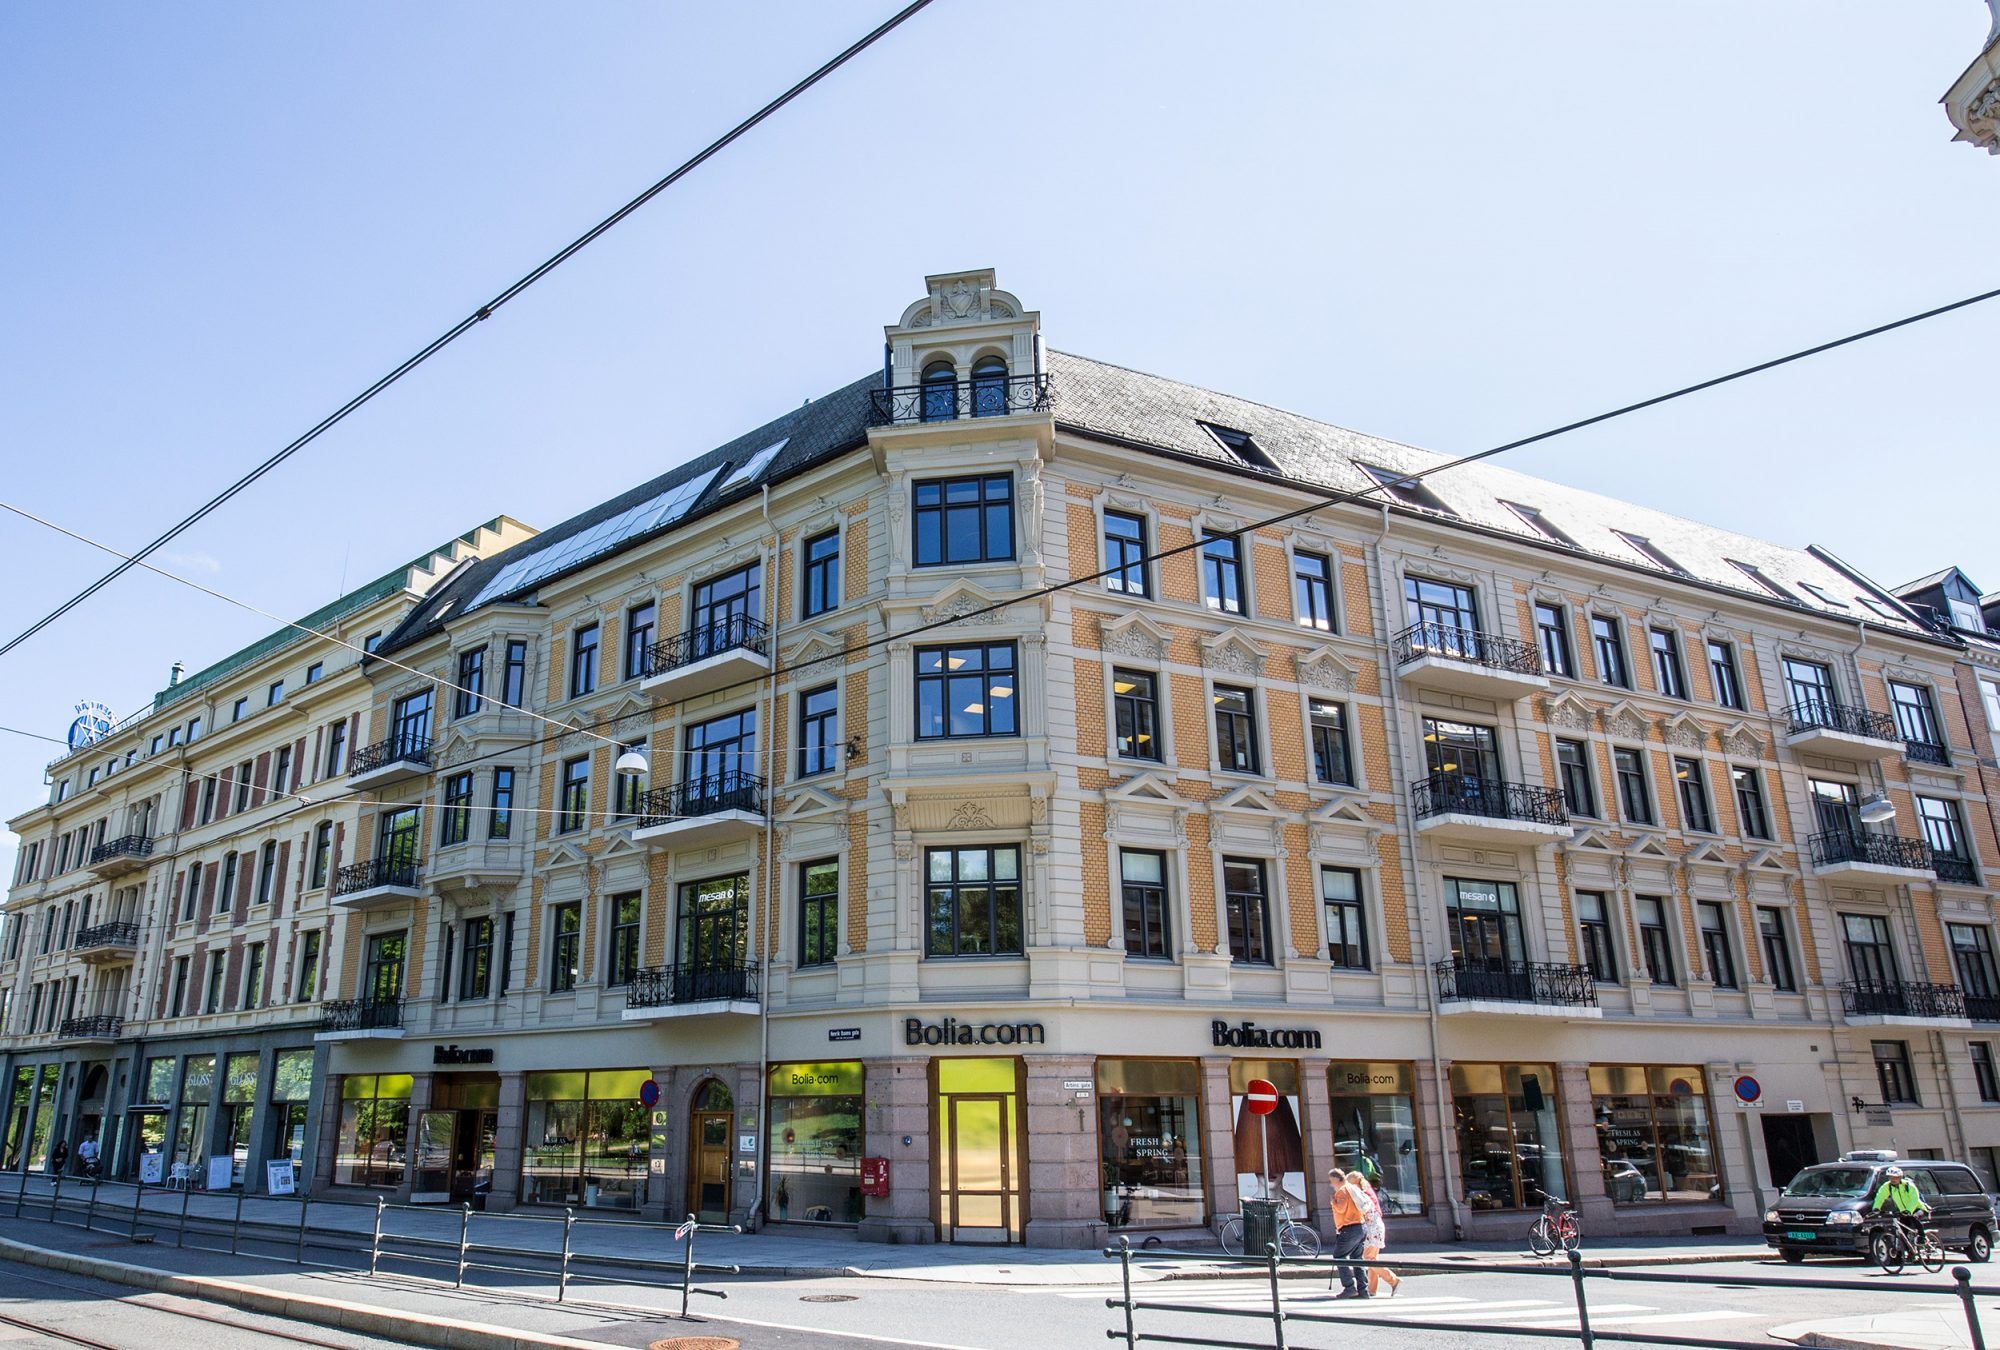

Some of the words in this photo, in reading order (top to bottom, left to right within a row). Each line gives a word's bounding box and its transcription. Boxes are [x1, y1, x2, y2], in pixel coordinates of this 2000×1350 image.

[699, 891, 726, 903] mesan
[1460, 891, 1488, 902] mesan
[906, 1017, 1044, 1046] Bolia.com
[1212, 1020, 1322, 1049] Bolia.com
[1611, 1129, 1632, 1137] FRESH
[1632, 1129, 1641, 1137] AS
[1131, 1137, 1159, 1146] FRESH
[1136, 1148, 1169, 1157] SPRING
